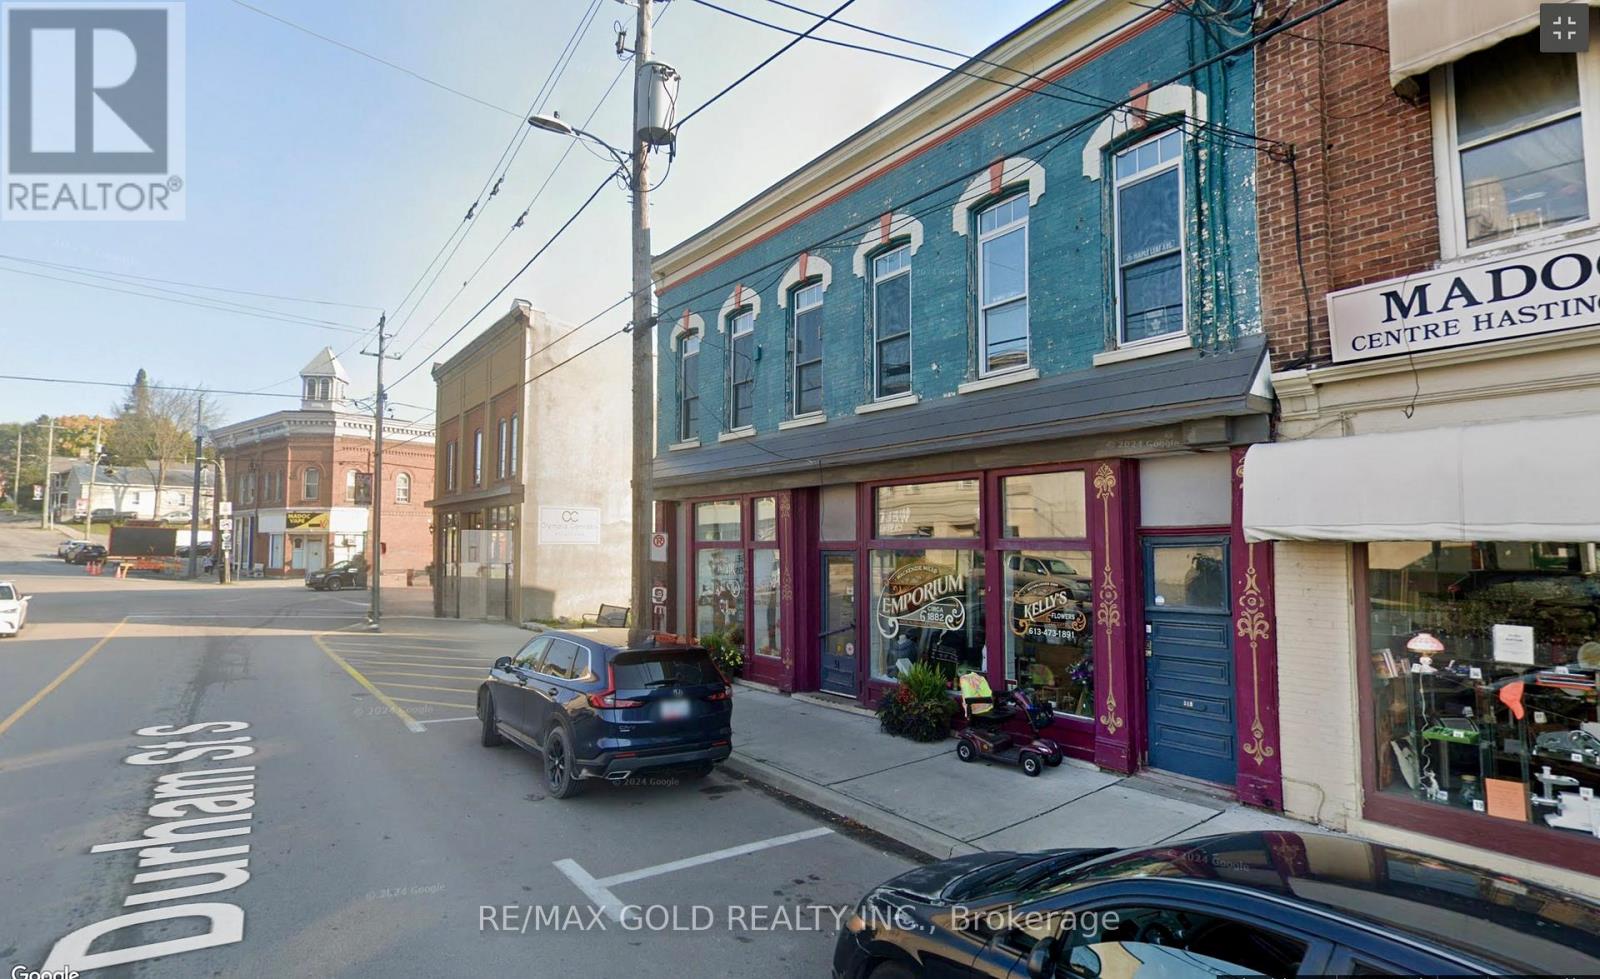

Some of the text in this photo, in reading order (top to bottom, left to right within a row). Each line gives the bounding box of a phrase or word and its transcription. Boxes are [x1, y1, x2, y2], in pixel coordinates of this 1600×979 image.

[1380, 253, 1600, 324] MADO
[1351, 294, 1600, 351] CENTRE HASTIN
[882, 574, 965, 614] EMPORIUM
[927, 605, 944, 613] CIRCA
[927, 612, 945, 622] 1882
[1024, 591, 1068, 622] KELLY'S
[1050, 612, 1076, 620] FLOWERS
[1028, 627, 1075, 639] 613-473-1891
